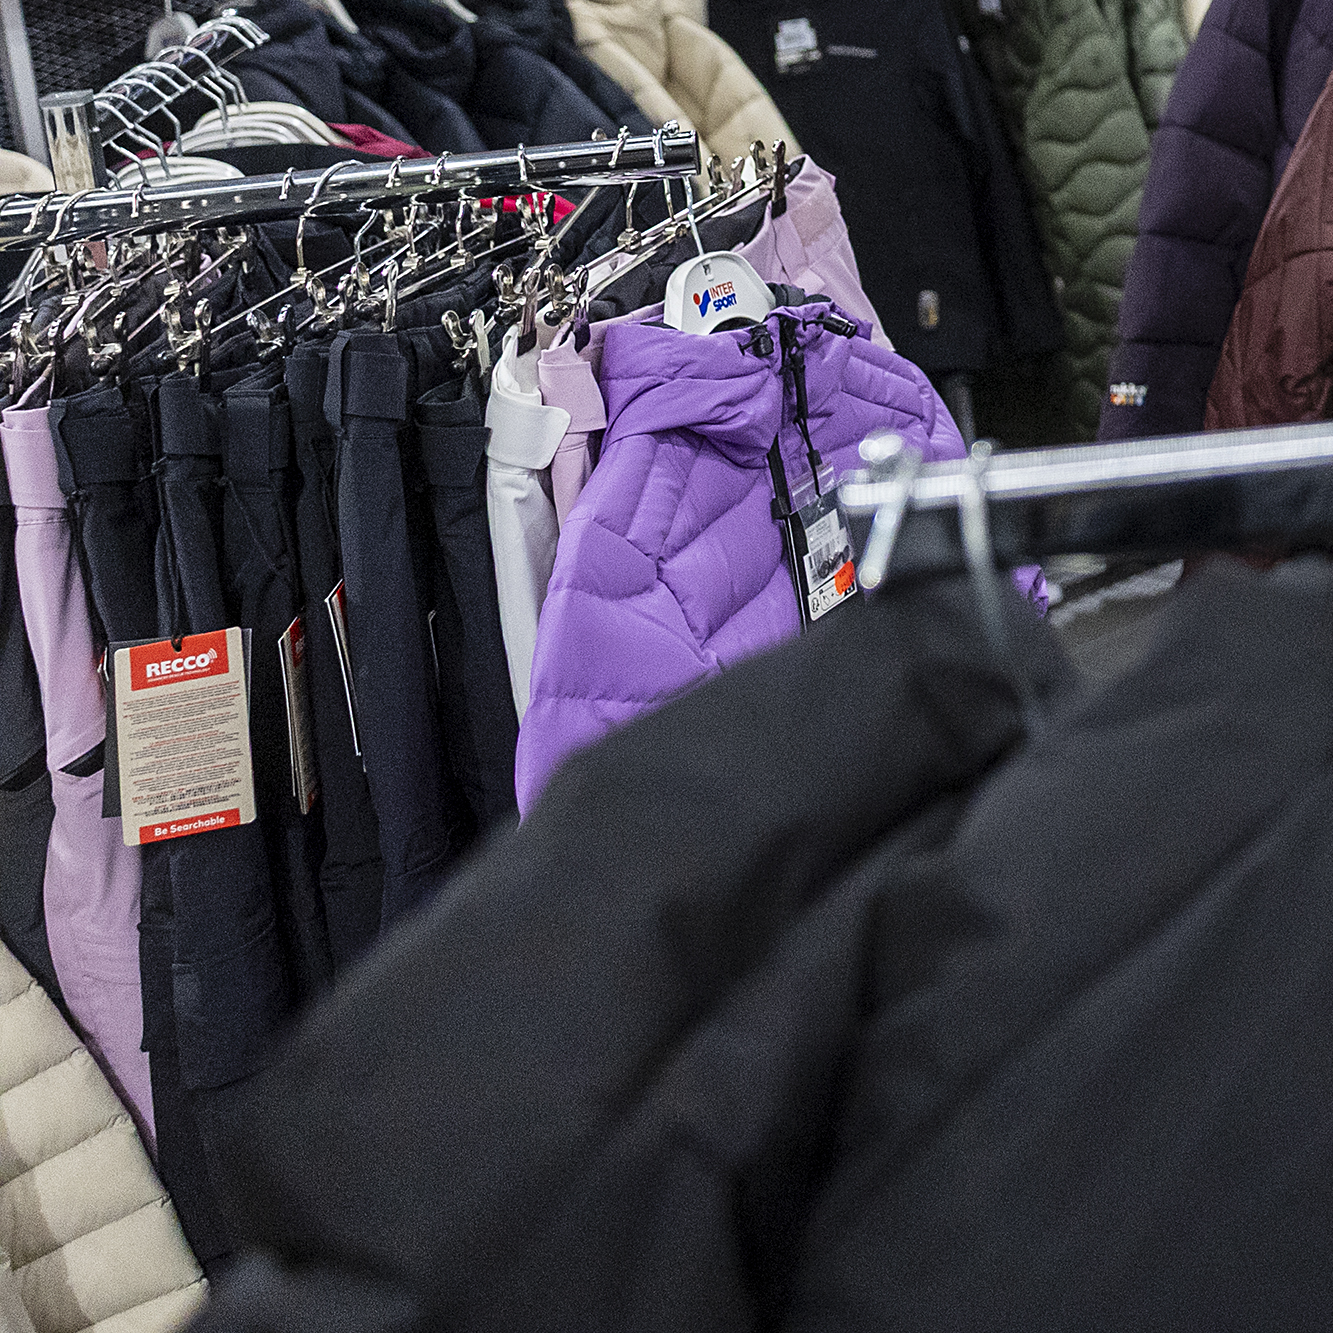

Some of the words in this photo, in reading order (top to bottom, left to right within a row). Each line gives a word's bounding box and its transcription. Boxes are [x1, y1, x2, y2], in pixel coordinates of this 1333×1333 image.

[709, 281, 735, 299] INTER
[713, 293, 738, 312] SPORT
[146, 653, 210, 678] RECCO
[154, 827, 168, 837] Be
[170, 815, 226, 834] Searchable
